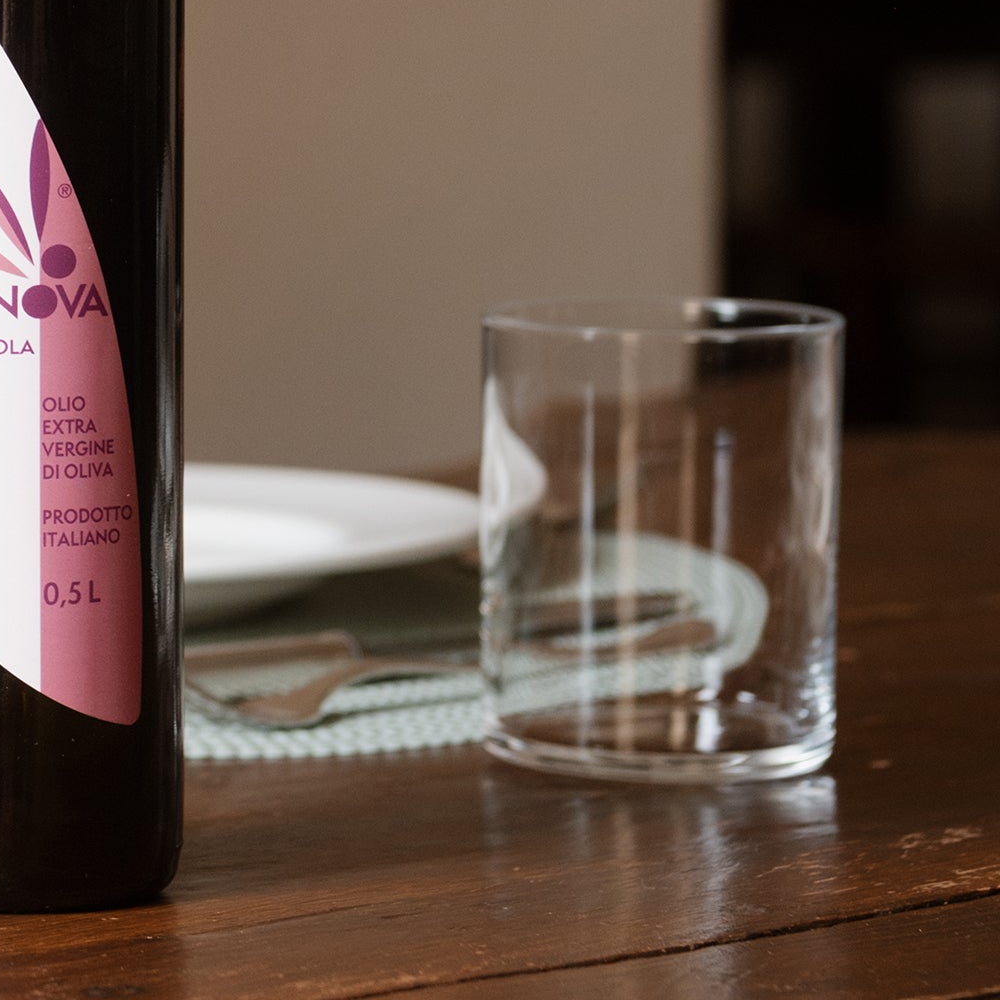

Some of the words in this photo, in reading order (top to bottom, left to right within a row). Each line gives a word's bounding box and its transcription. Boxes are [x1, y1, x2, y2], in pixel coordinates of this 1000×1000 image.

[42, 396, 85, 412] OLIO
[43, 419, 97, 435] EXTRA
[42, 440, 115, 457] VERGINE
[43, 465, 59, 480] DI
[64, 462, 113, 479] OLIVA
[43, 505, 132, 525] PRODOTTO
[43, 529, 120, 547] ITALIANO
[43, 582, 81, 608] 0,5
[89, 580, 101, 603] L
